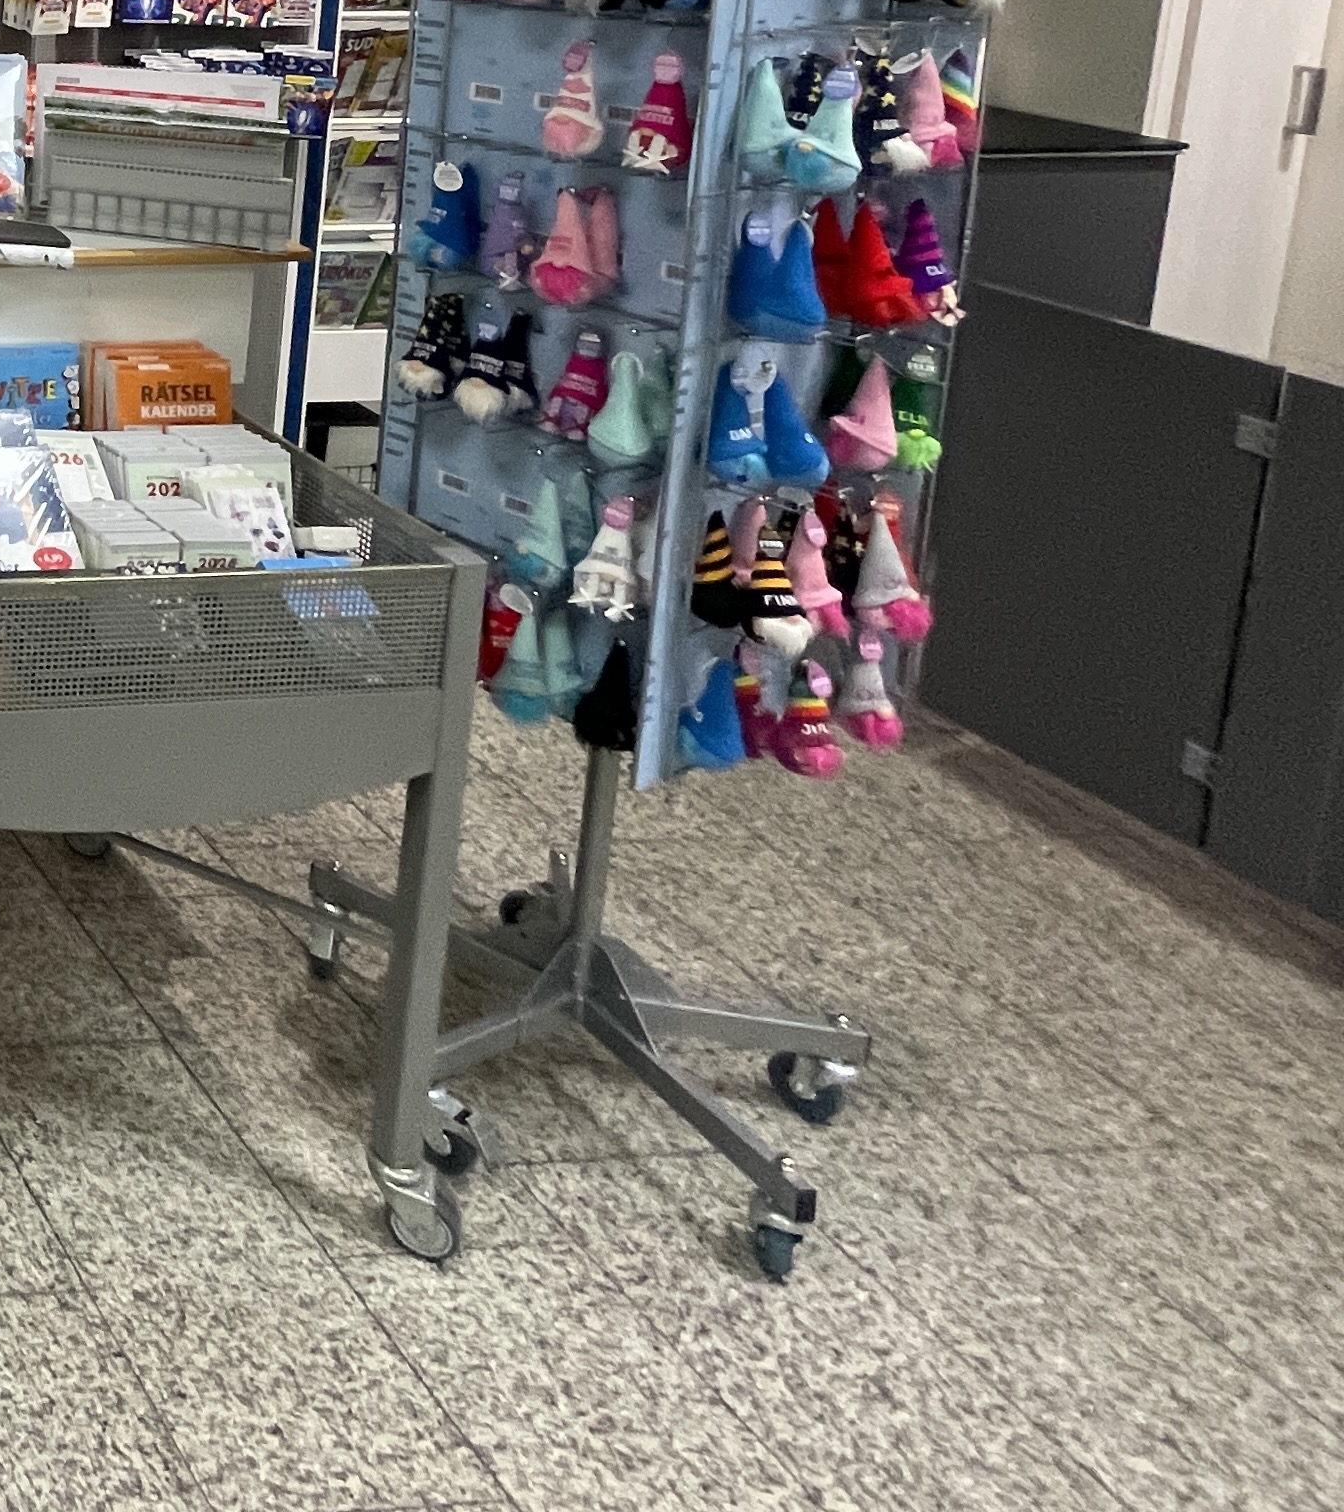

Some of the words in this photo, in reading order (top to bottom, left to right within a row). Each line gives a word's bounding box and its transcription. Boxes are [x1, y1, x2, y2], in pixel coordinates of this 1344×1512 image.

[141, 381, 217, 403] RÄTSEL
[141, 403, 216, 419] KALENDER
[147, 482, 181, 497] 202
